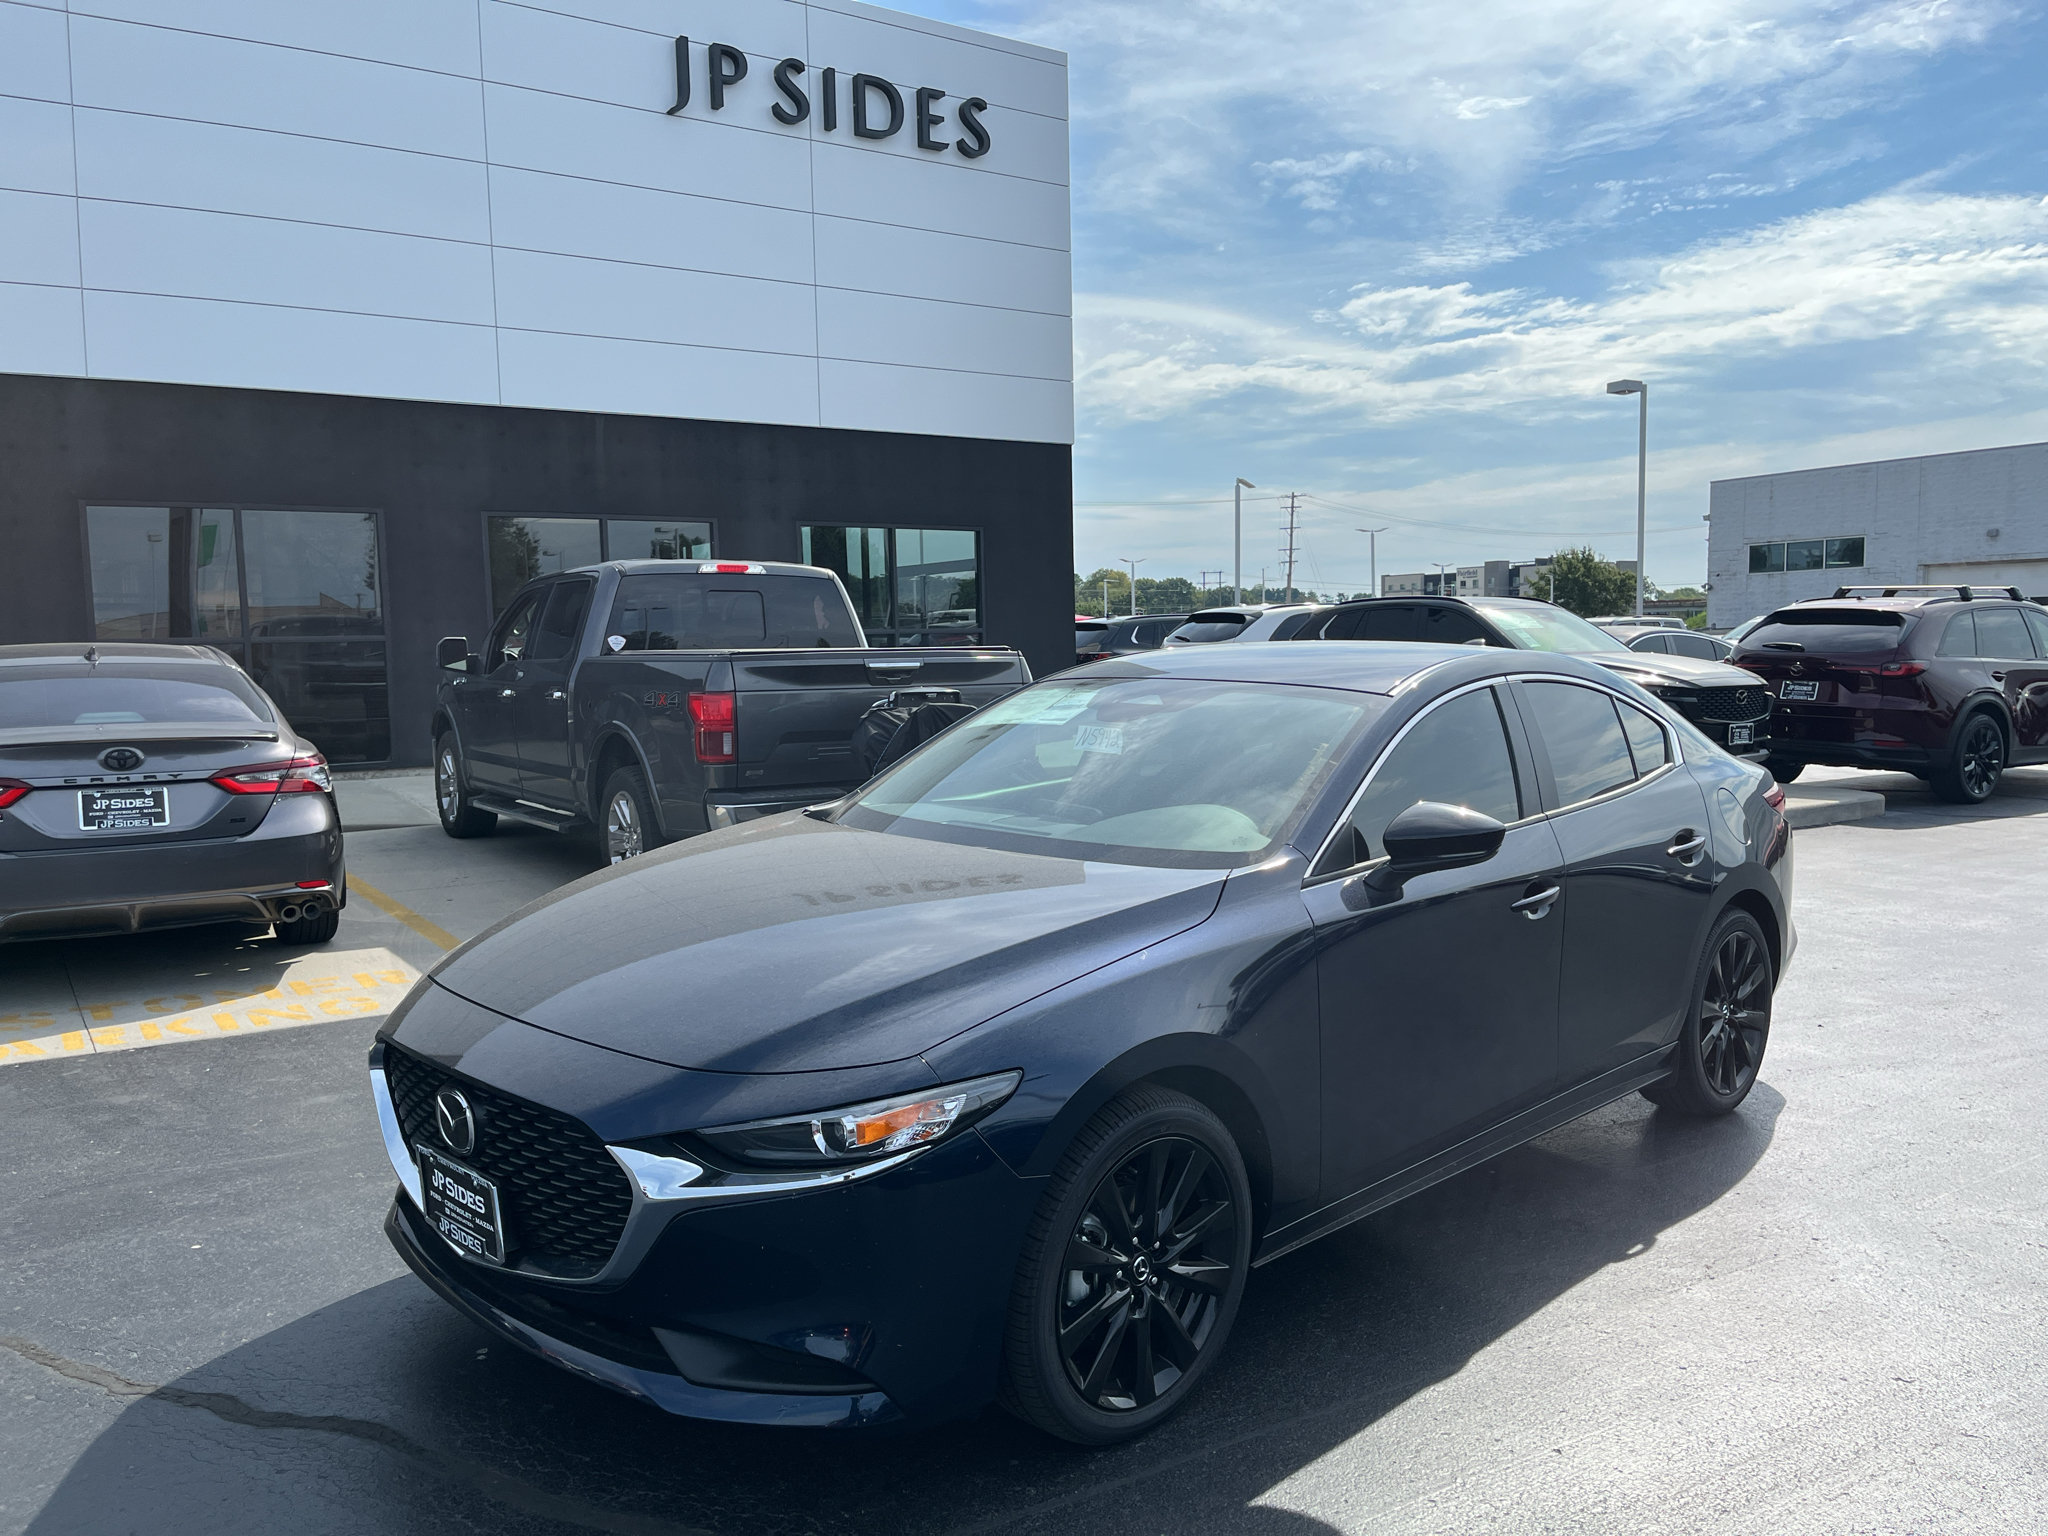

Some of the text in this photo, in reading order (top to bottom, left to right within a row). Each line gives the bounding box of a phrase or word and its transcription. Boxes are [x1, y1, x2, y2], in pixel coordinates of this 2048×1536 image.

[667, 35, 991, 159] JP SIDES
[93, 797, 154, 810] JP SIDES
[100, 819, 149, 828] JP SIDES
[432, 1168, 485, 1214] JP SIDES
[439, 1217, 449, 1235] JP
[450, 1224, 482, 1254] SIDES
[475, 1217, 494, 1232] MAZDA
